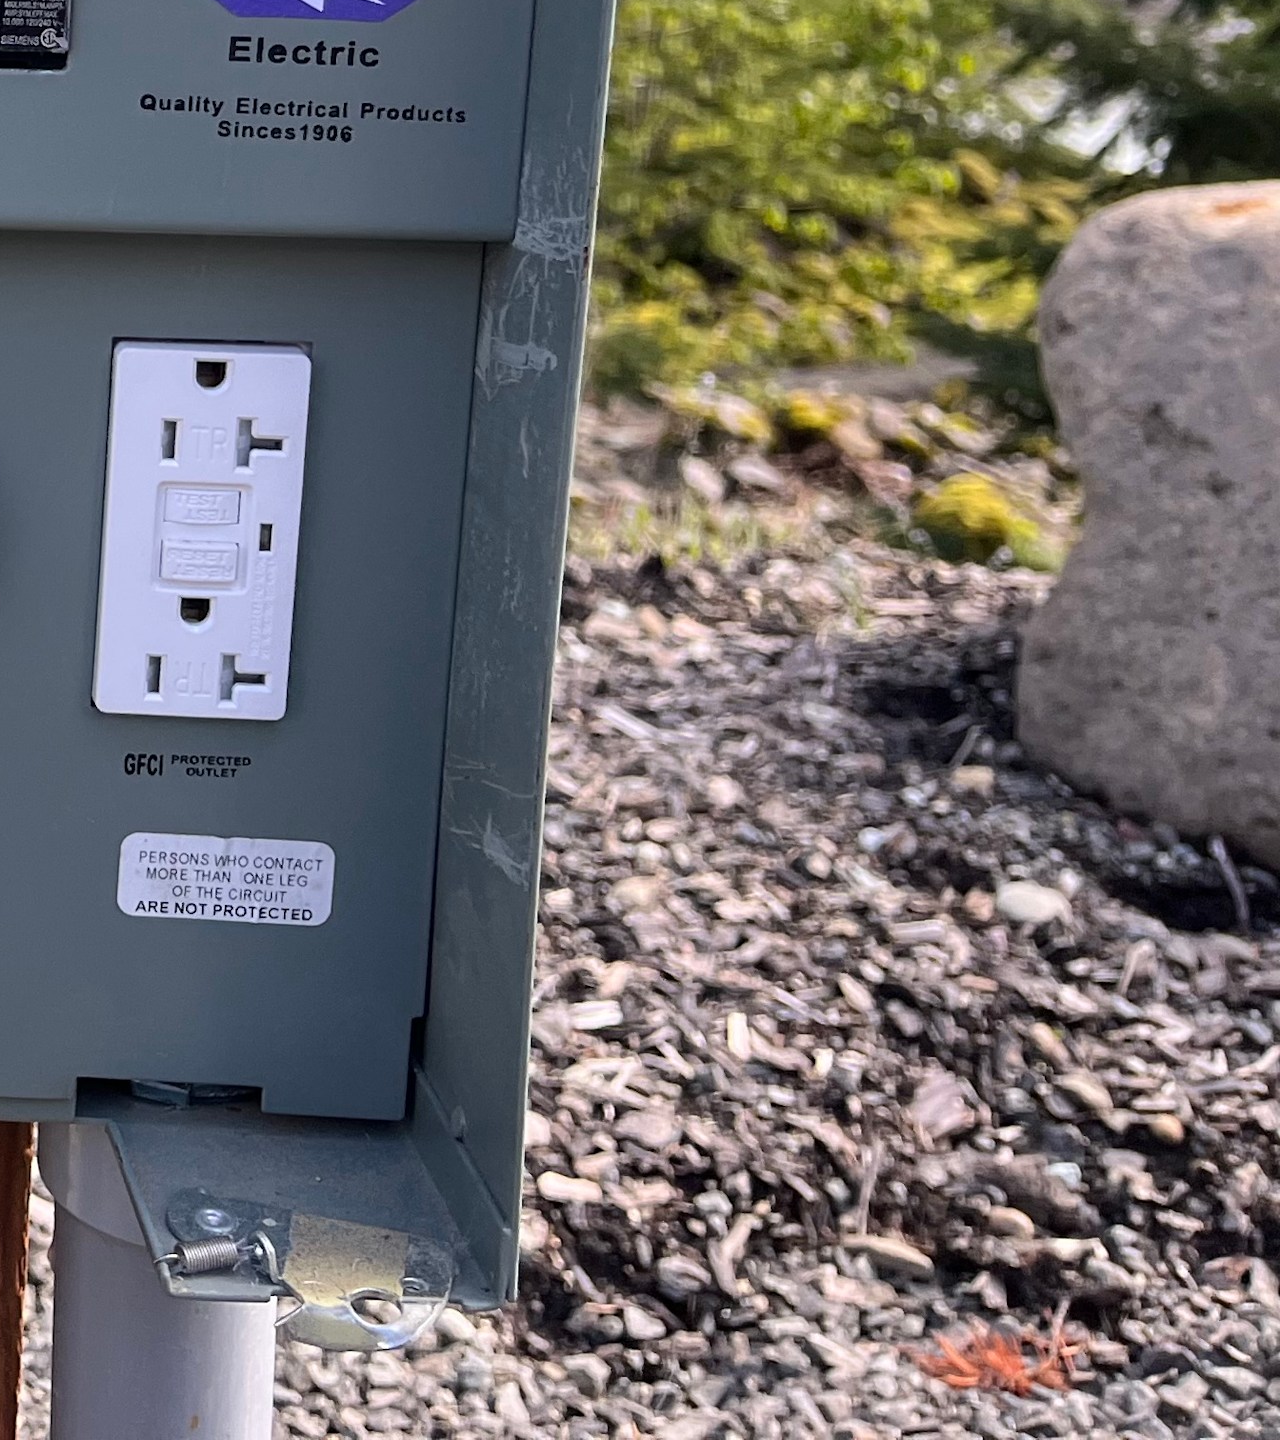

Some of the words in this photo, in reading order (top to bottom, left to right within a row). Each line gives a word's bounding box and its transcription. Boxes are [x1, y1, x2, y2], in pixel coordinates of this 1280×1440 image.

[0, 34, 40, 47] SIEMENS
[228, 35, 379, 68] Electric
[139, 93, 225, 118] Quality
[236, 97, 349, 119] Electrical
[360, 102, 466, 123] Products
[217, 120, 353, 143] Sinces1906
[123, 752, 164, 776] GFCI
[171, 754, 252, 767] PROTECTED
[185, 767, 238, 778] OUTLET
[138, 850, 210, 866] PERSONS
[214, 854, 249, 869] WHO
[253, 855, 323, 872] CONTACT
[146, 866, 188, 882] MORE
[195, 869, 231, 883] THAN
[243, 871, 274, 886] ONE
[279, 874, 308, 888] LEG
[171, 884, 192, 898] OF
[196, 885, 224, 902] THE
[228, 887, 287, 904] CIRCUIT
[135, 900, 169, 914] ARE
[174, 902, 207, 916] NOT
[212, 904, 313, 922] PROTECTED
